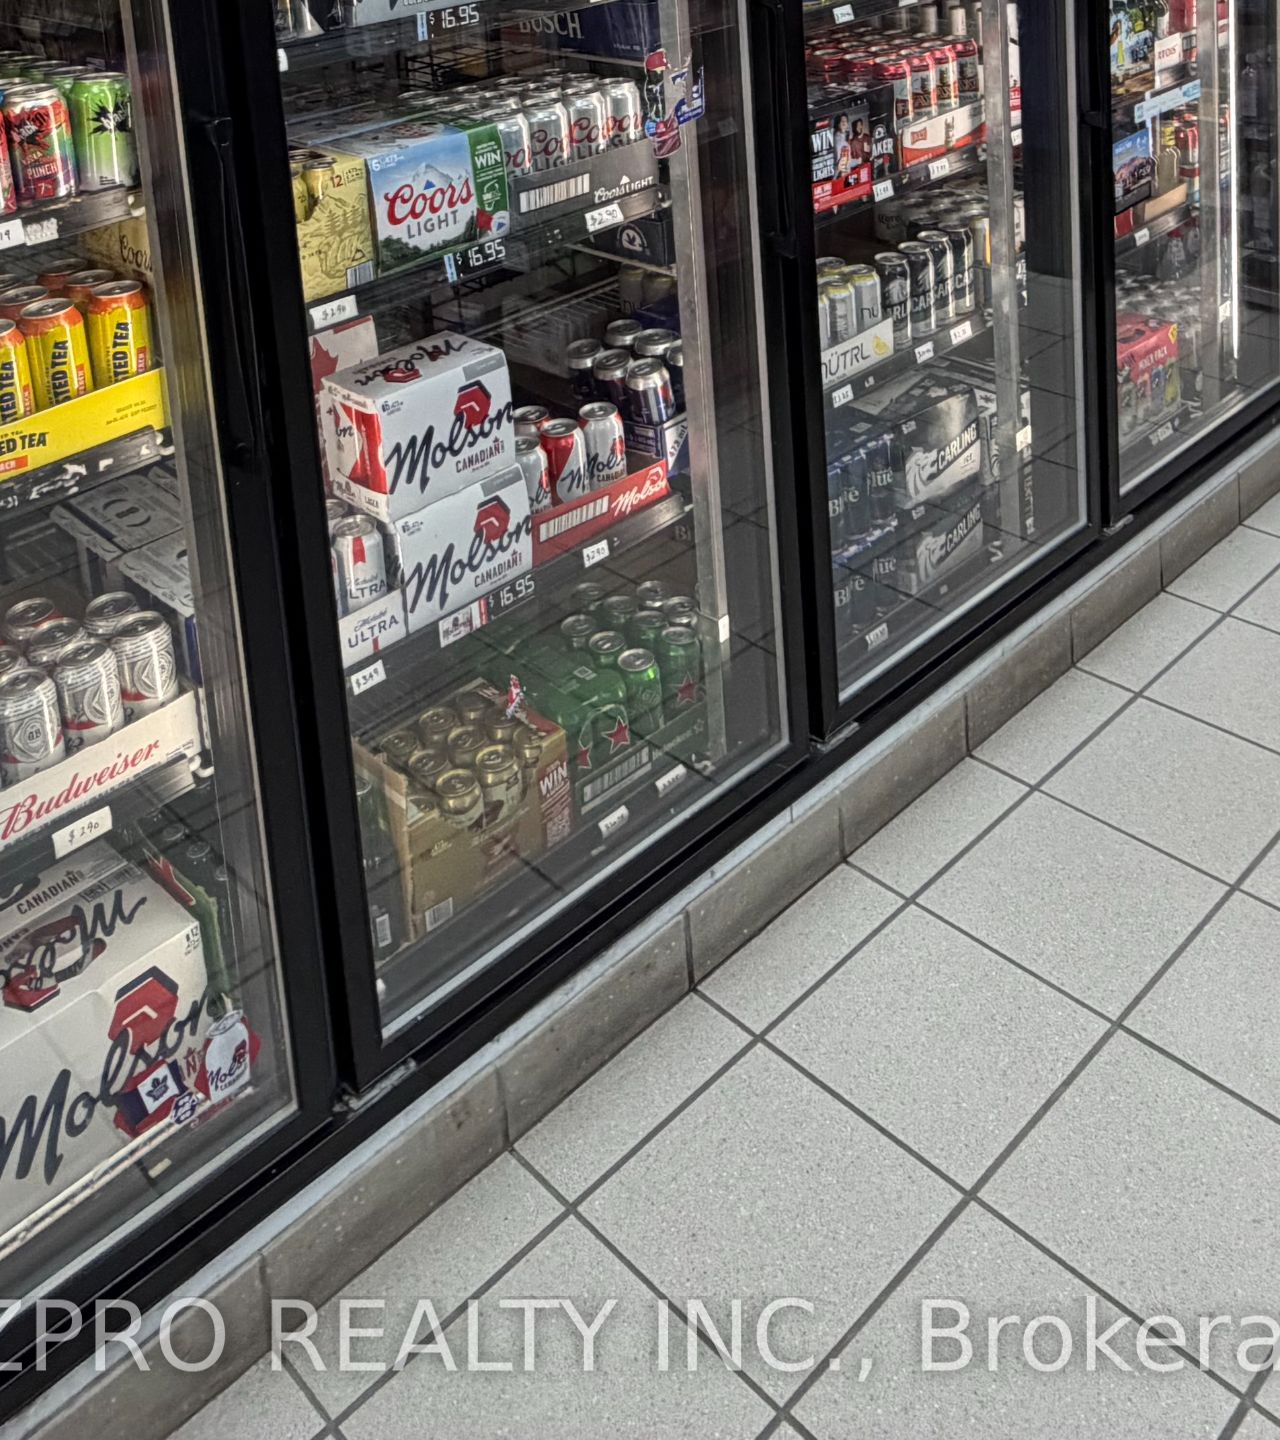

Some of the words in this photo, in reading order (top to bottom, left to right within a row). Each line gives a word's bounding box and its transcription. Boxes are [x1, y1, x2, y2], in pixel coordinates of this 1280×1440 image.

[440, 4, 480, 31] 16.95
[811, 127, 835, 153] WIN
[475, 151, 502, 167] WIN
[383, 177, 475, 226] Coors
[407, 210, 460, 240] LIGHT
[467, 238, 506, 269] 16.95
[21, 431, 49, 450] TEA
[385, 400, 515, 494] Molson
[455, 439, 502, 474] CANADIAN
[937, 419, 978, 471] CARLING
[611, 475, 668, 518] Molson
[946, 508, 981, 551] CARLING
[404, 512, 533, 614] Molson
[473, 551, 523, 588] CANADIAN
[499, 575, 536, 606] 16.95
[347, 612, 400, 649] ULTRA
[539, 762, 569, 797] WIN
[16, 868, 87, 916] CANADIAN
